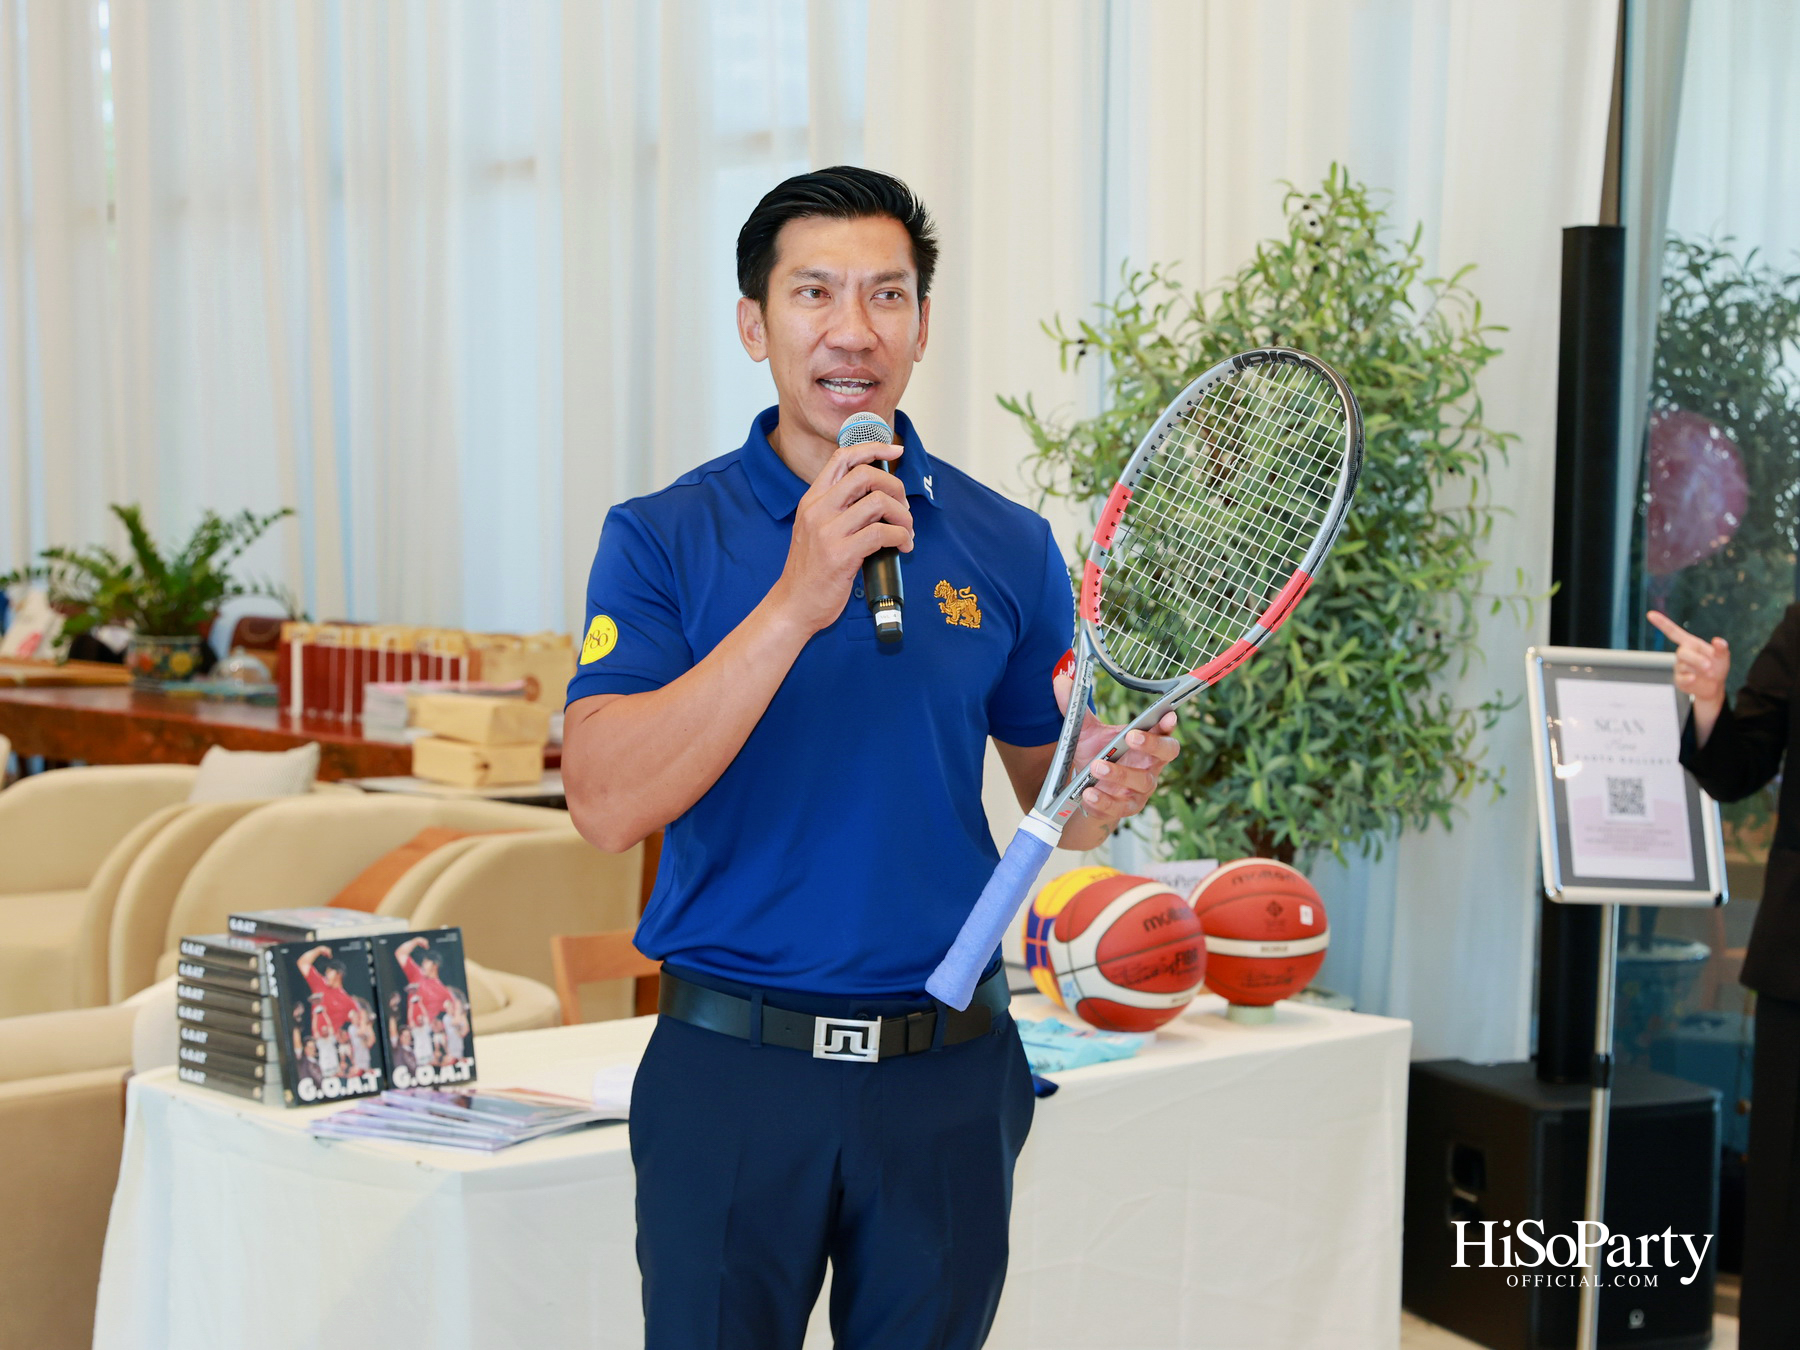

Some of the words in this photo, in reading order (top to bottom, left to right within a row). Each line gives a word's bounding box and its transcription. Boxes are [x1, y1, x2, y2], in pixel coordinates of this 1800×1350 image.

[1594, 717, 1645, 734] SCAN
[298, 1068, 382, 1101] G.O.A.T
[392, 1056, 474, 1089] G.O.A.T
